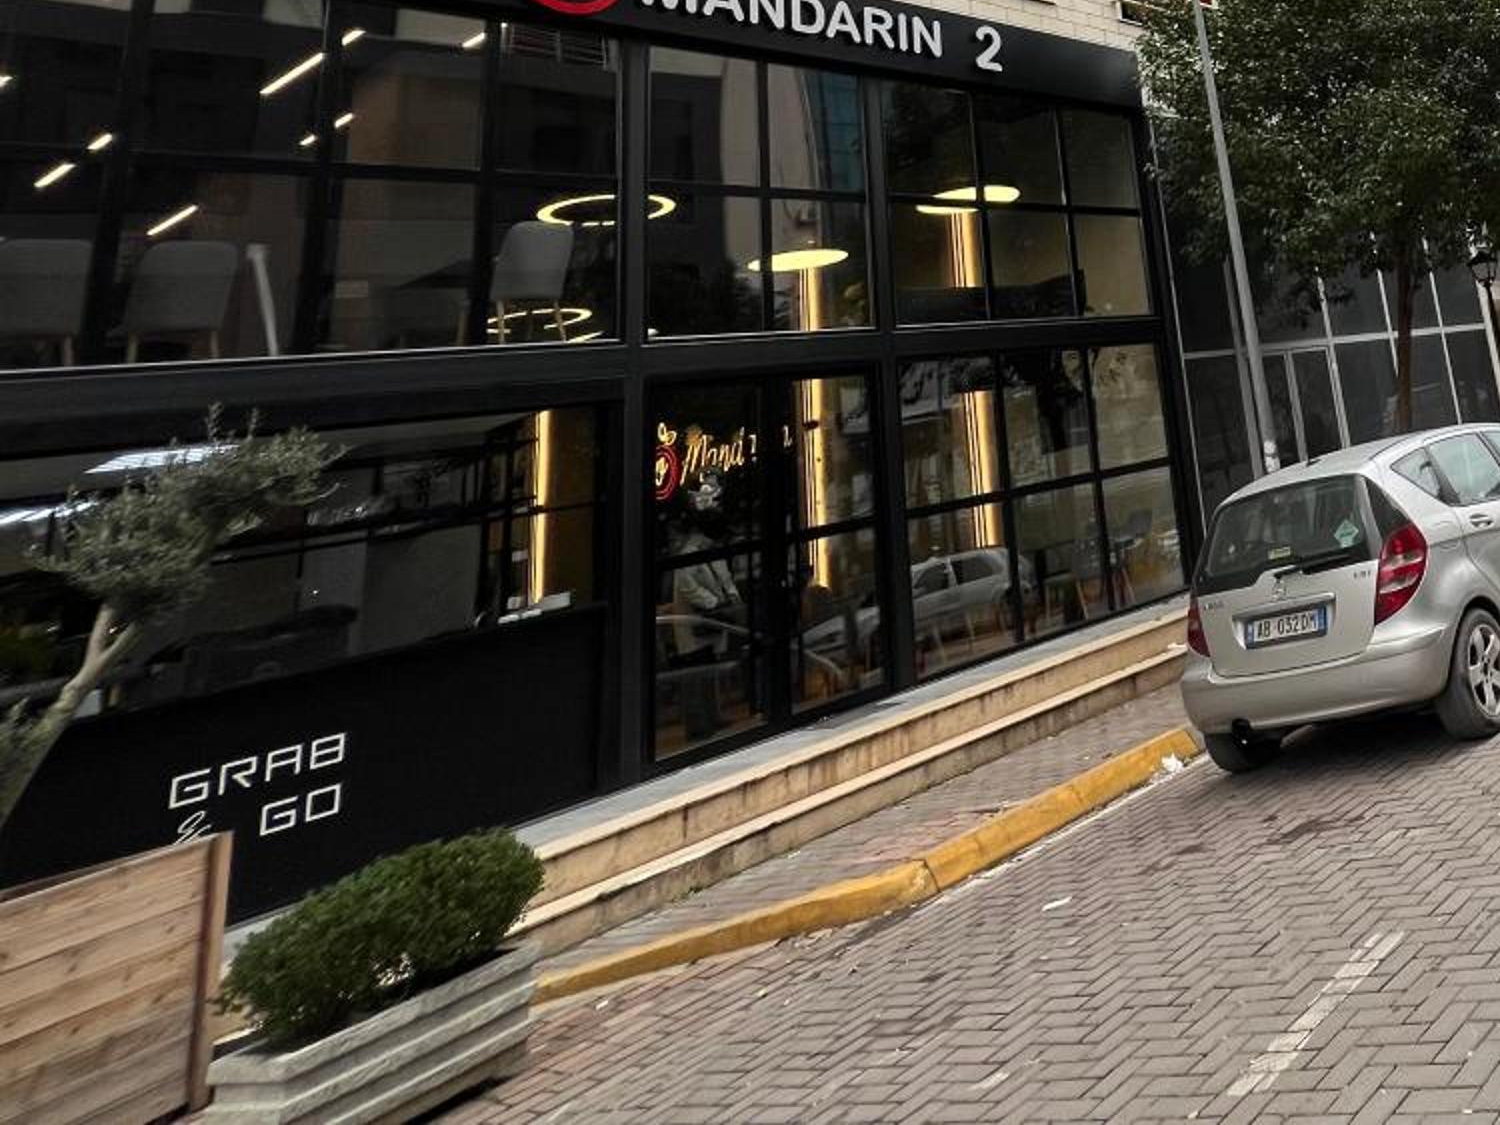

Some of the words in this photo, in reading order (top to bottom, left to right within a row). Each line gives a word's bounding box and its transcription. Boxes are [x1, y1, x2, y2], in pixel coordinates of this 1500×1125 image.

[974, 25, 1003, 73] 2
[168, 732, 347, 810] GRAB
[259, 782, 342, 837] GO
